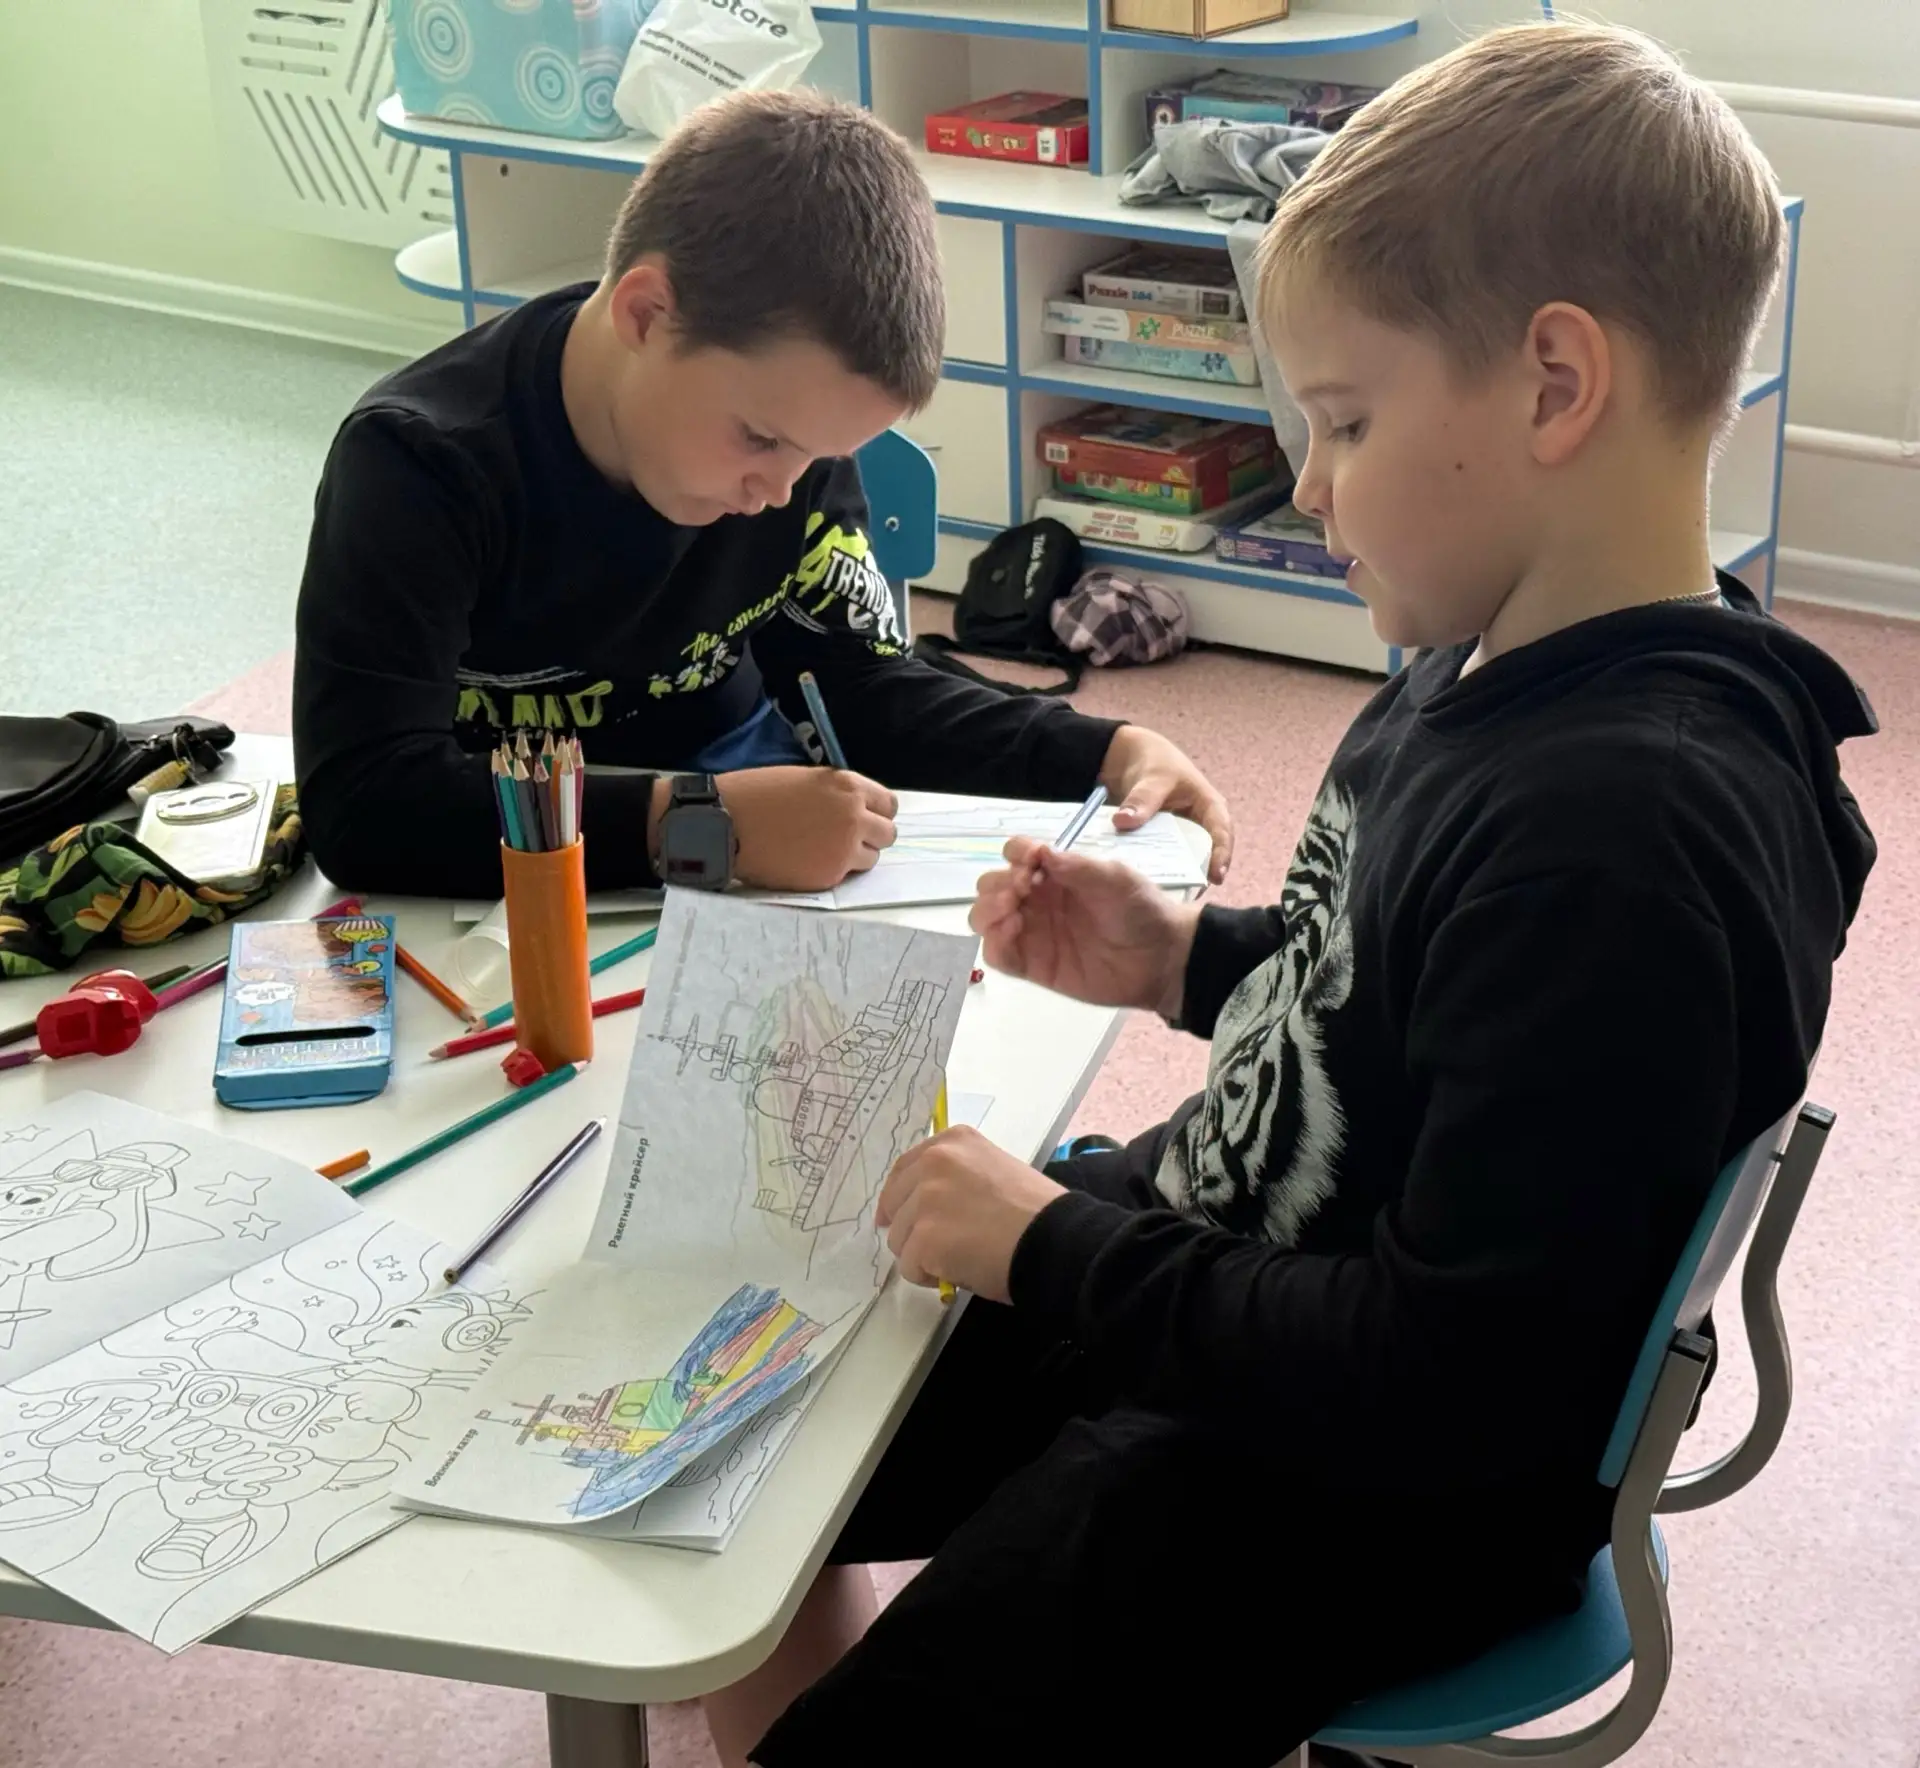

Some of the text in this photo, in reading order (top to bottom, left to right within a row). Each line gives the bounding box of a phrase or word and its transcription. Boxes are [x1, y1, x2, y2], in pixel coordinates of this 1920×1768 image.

[1088, 284, 1129, 300] Puzzle
[680, 631, 722, 662] the
[727, 573, 795, 637] concert
[607, 1137, 650, 1249] Ракетный крейсер
